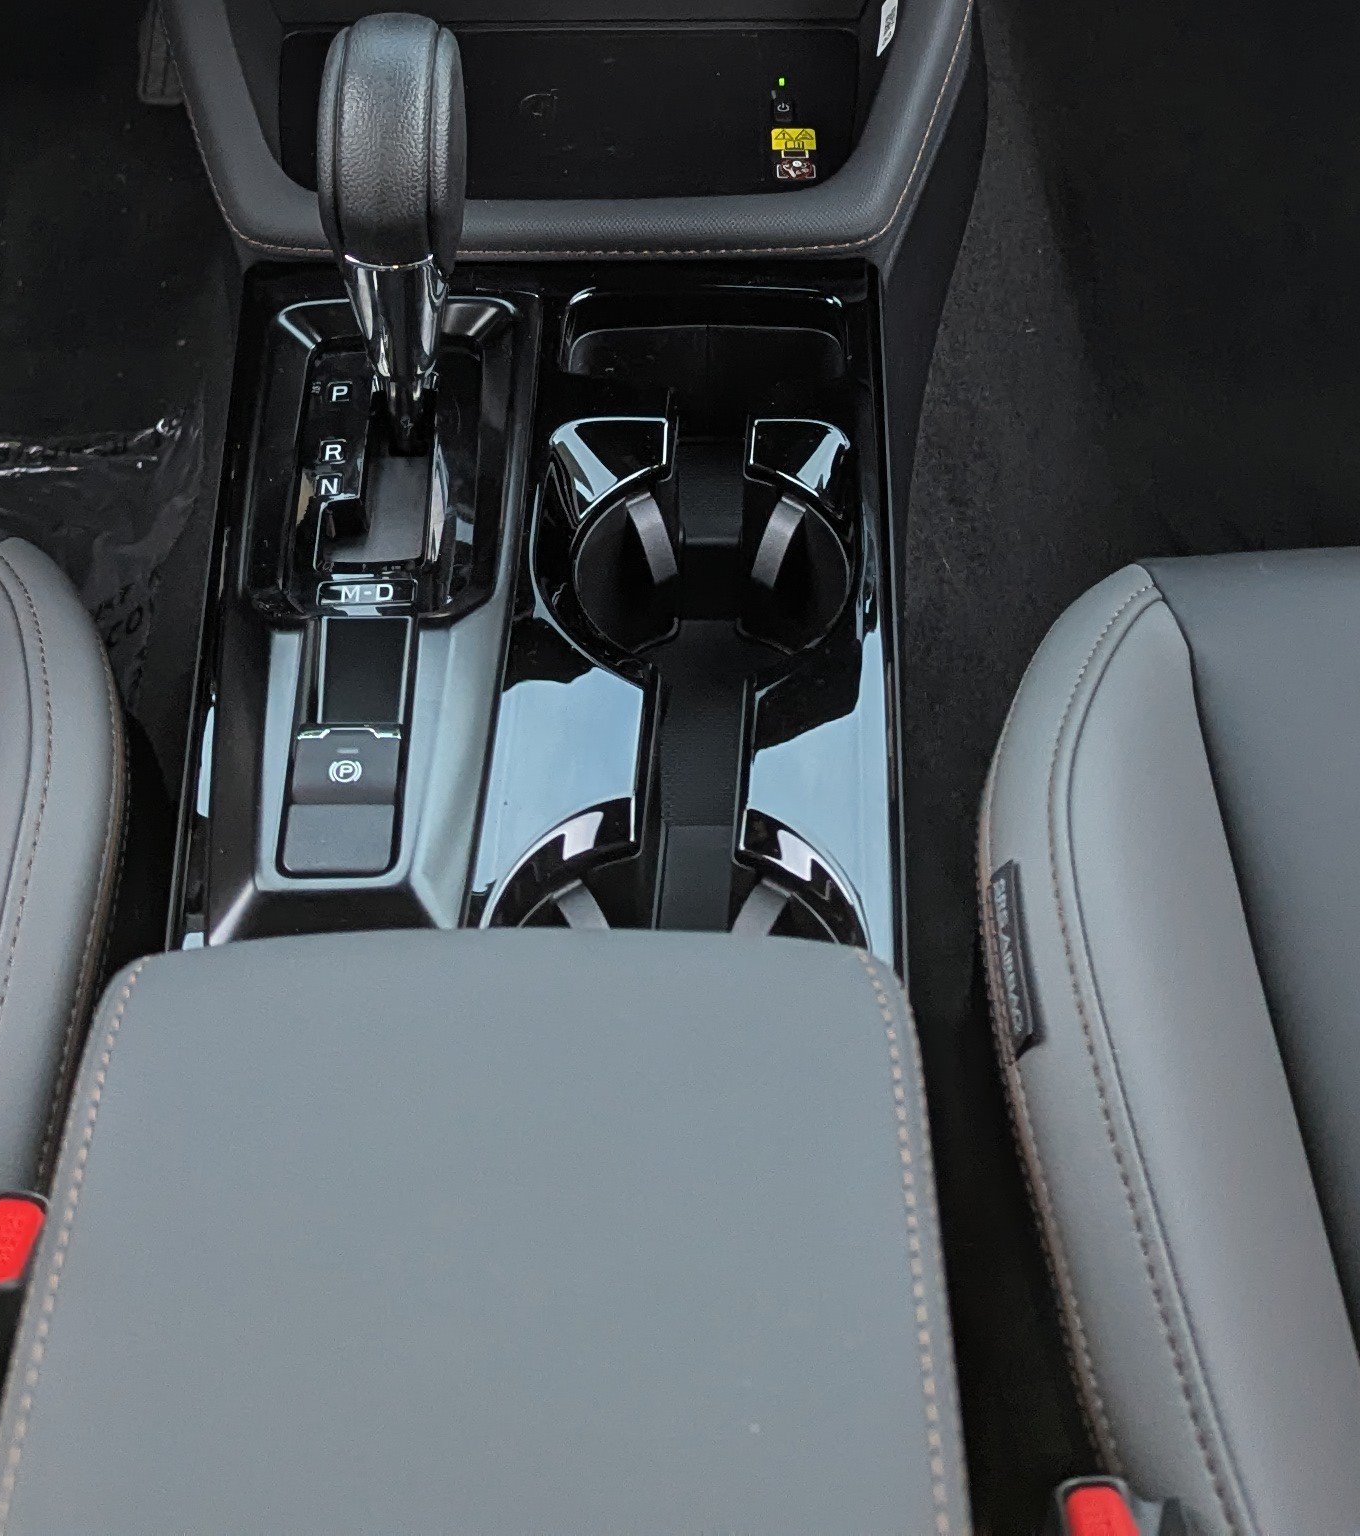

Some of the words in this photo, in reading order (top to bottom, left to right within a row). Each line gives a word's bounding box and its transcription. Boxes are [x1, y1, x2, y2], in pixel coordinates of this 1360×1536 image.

[332, 386, 349, 402] P
[325, 444, 342, 460] R
[321, 478, 338, 494] N
